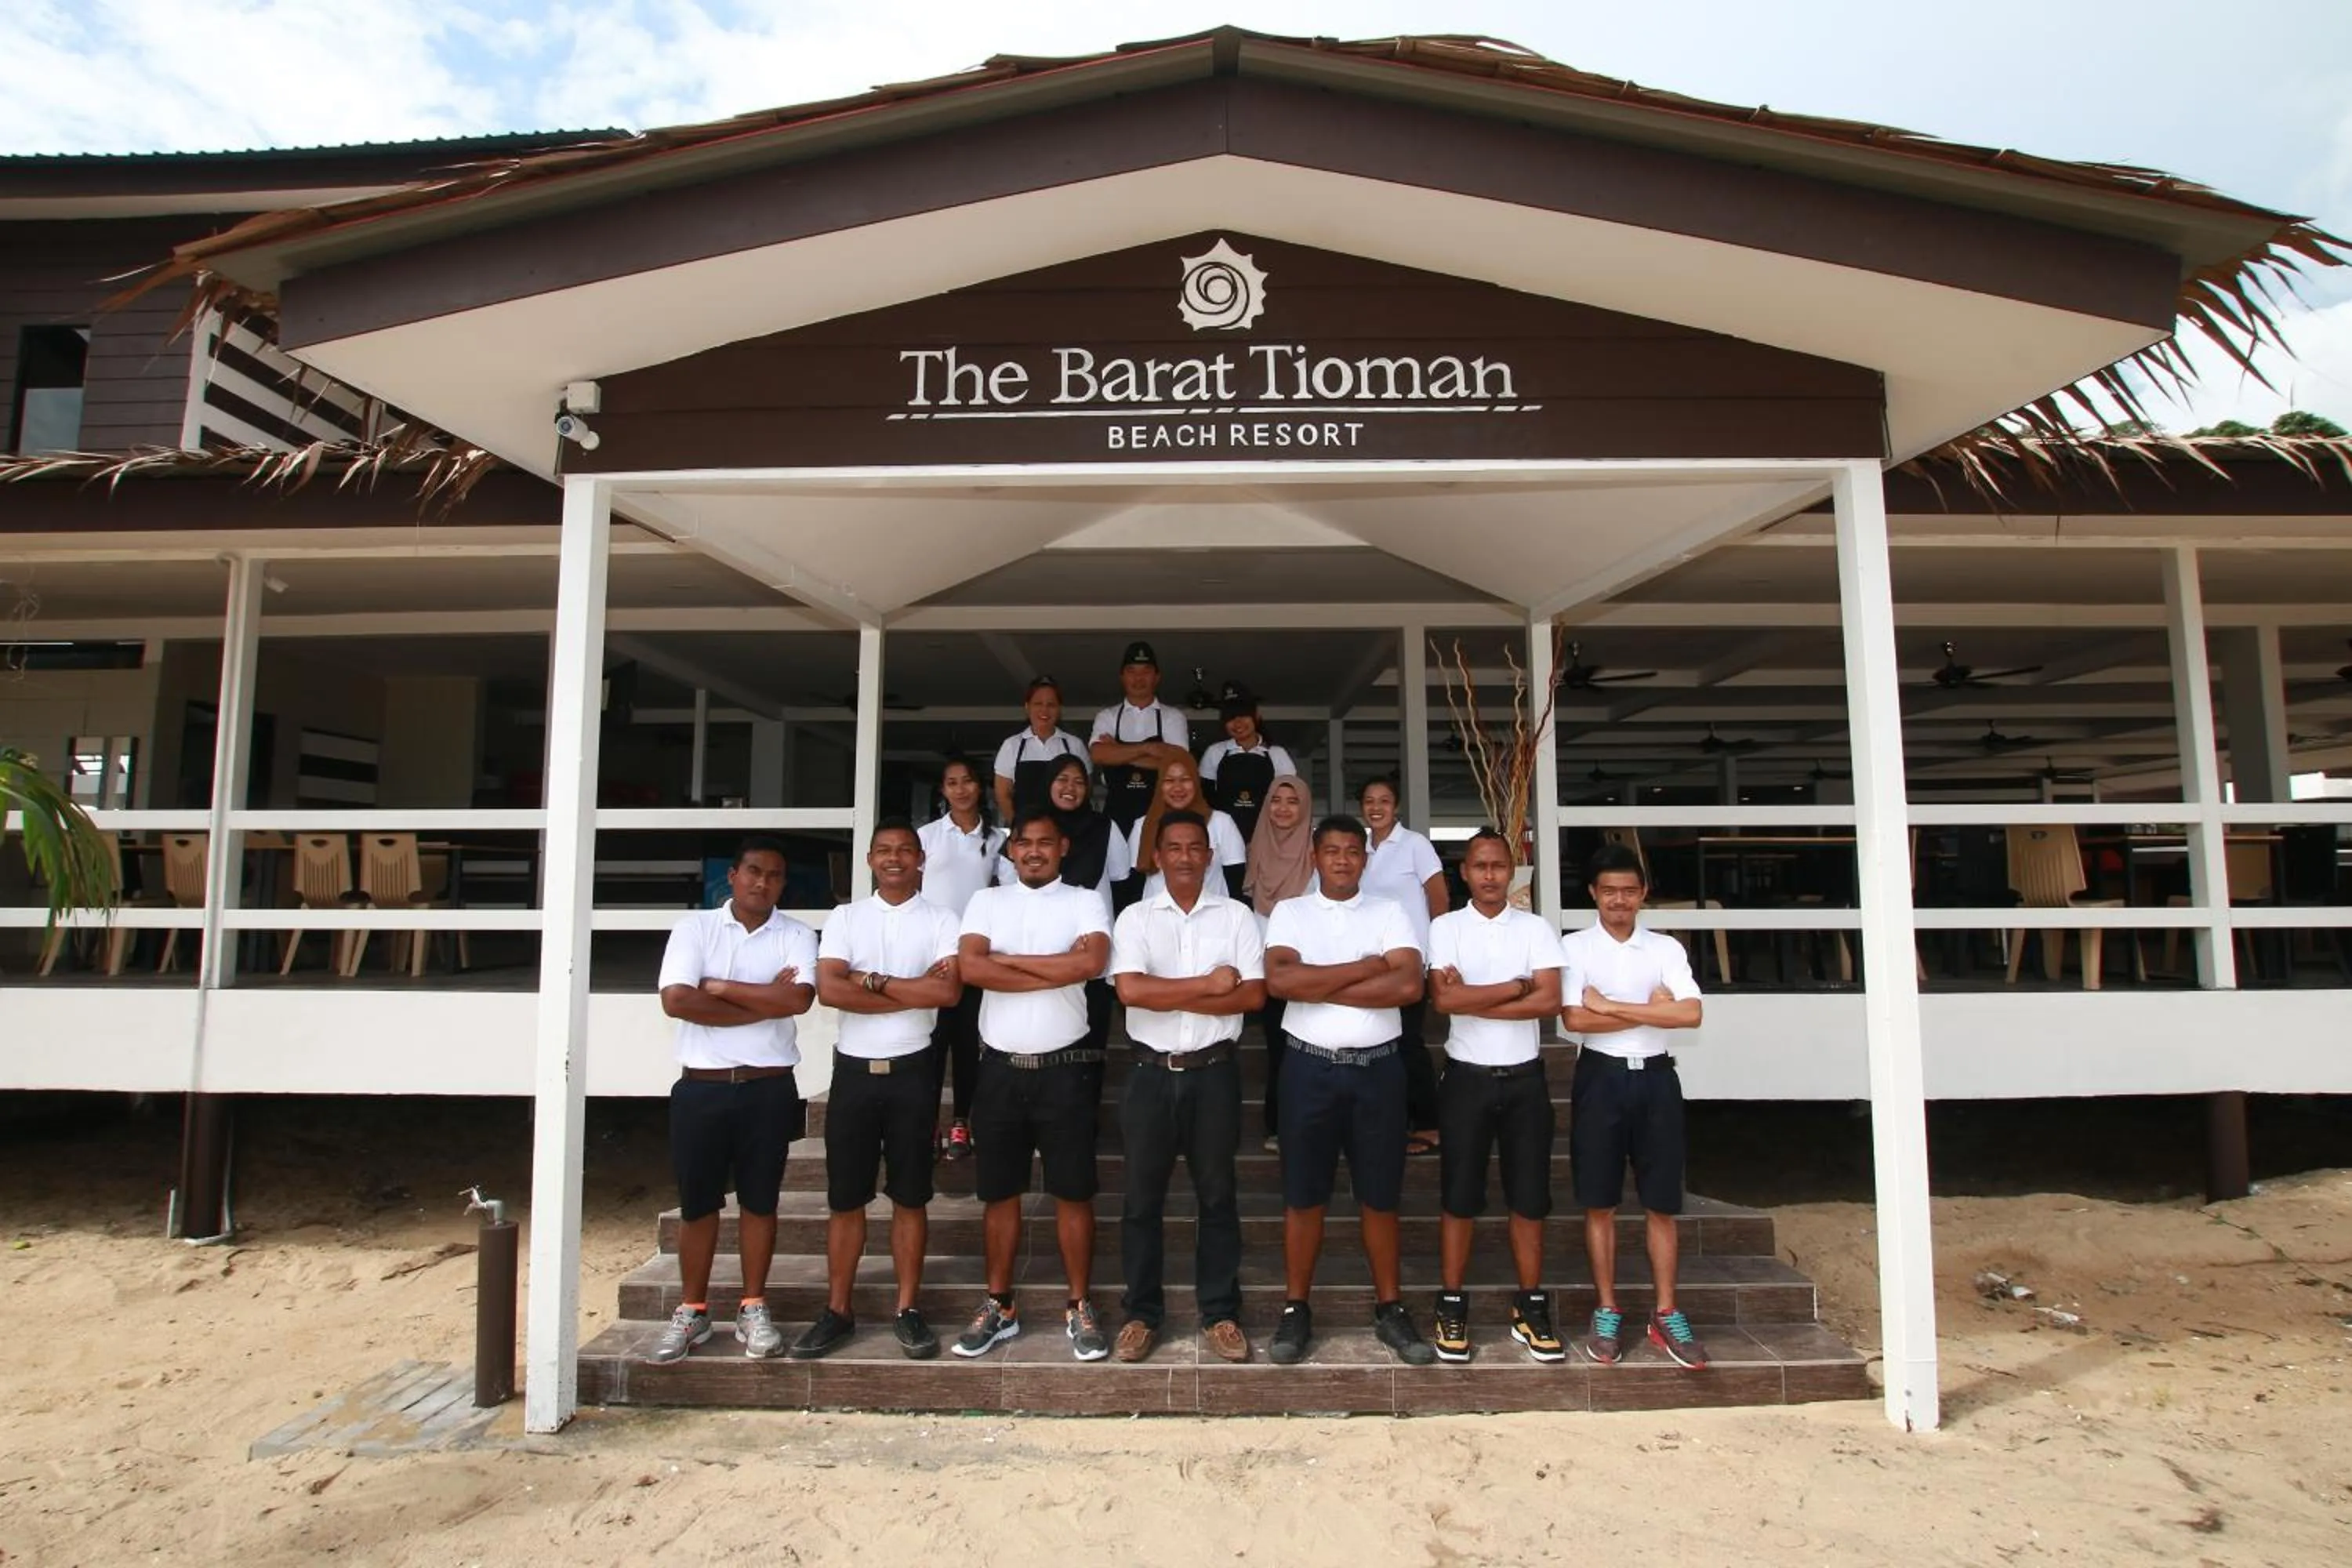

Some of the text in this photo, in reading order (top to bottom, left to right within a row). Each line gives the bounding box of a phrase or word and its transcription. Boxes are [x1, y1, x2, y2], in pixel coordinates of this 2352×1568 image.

[899, 345, 1517, 405] The Barat Tioman
[1108, 423, 1363, 449] BEACH RESORT
